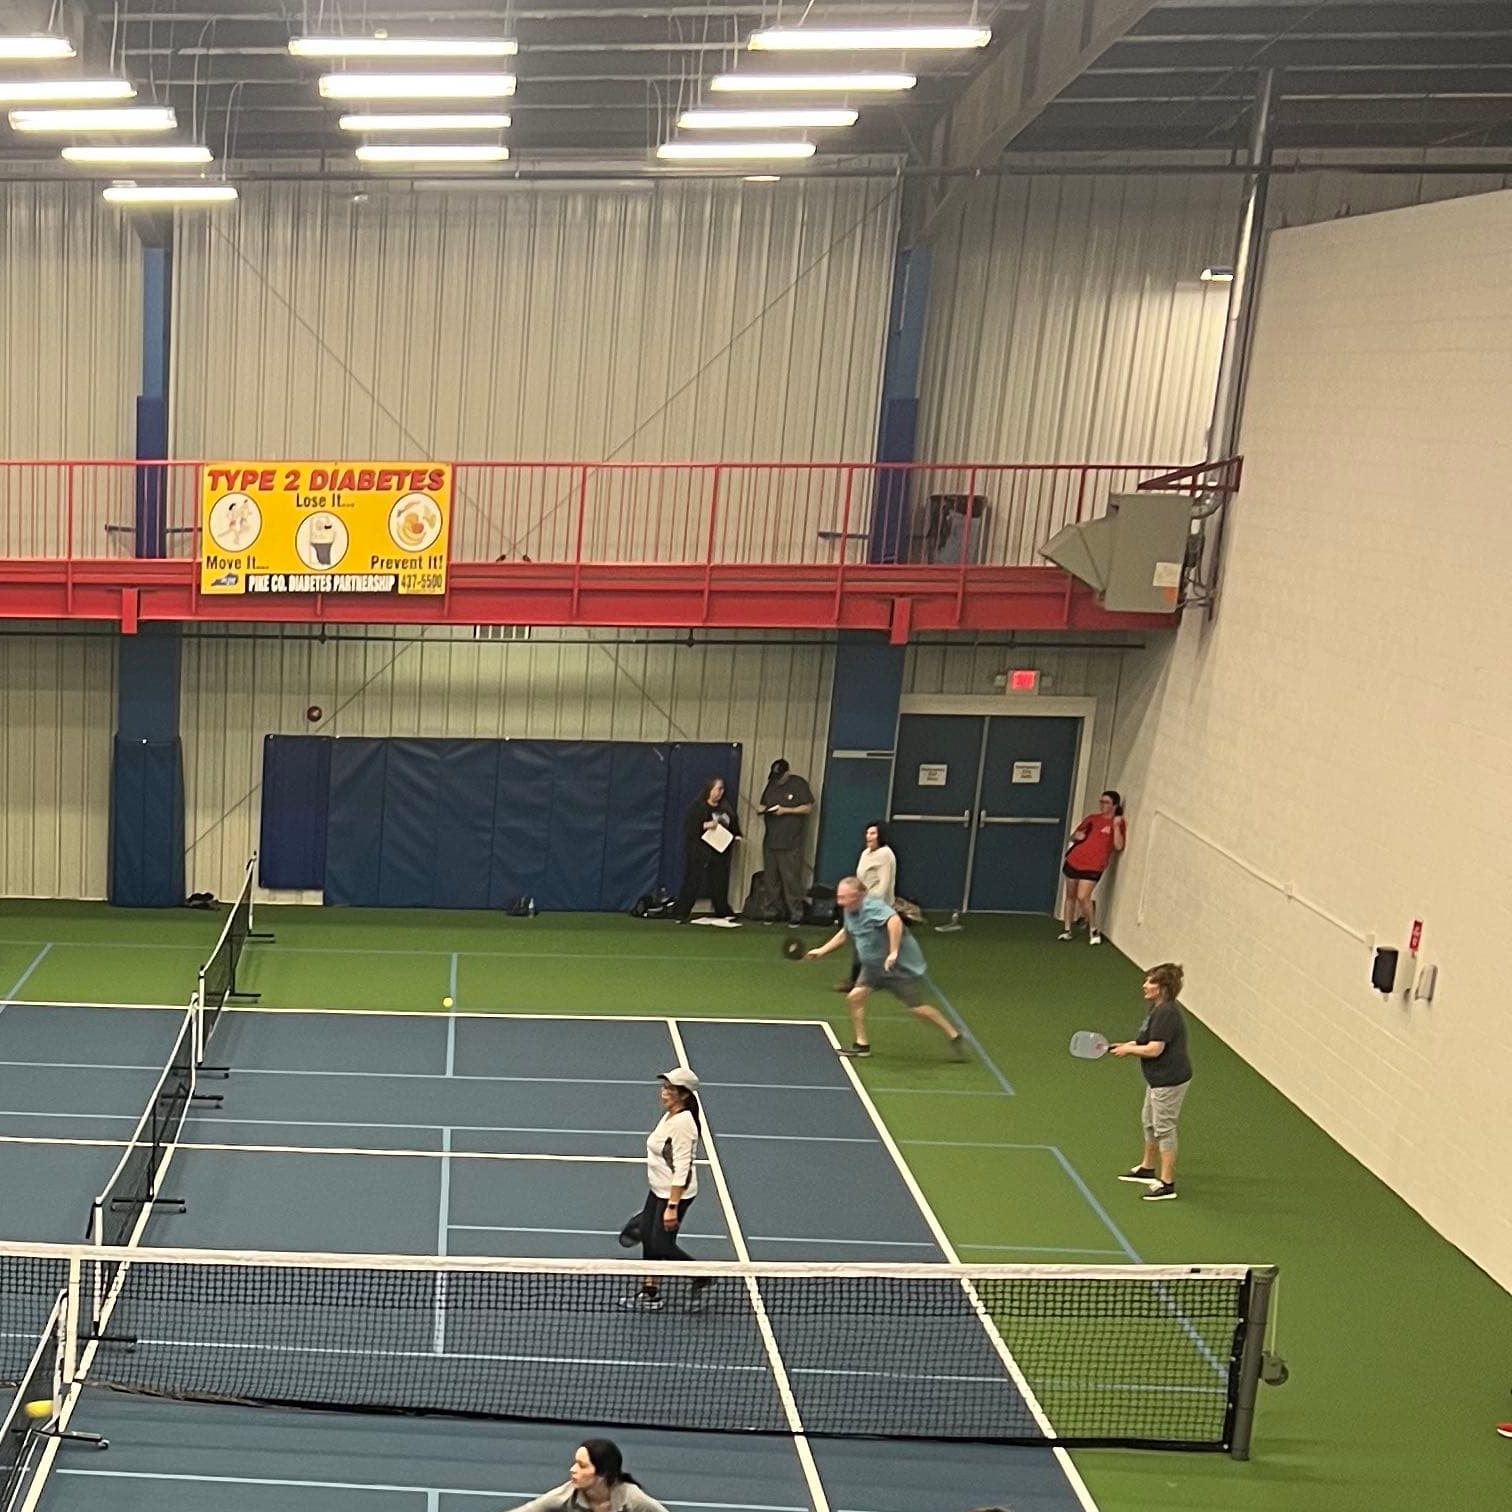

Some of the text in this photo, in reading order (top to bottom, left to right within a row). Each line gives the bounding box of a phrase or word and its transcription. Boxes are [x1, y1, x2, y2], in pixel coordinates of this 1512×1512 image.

[208, 469, 445, 491] TYPE 2 DIABETES
[296, 493, 327, 508] Lose
[206, 556, 242, 570] Move
[370, 555, 443, 570] Prevent It!
[248, 574, 396, 592] PIKE CO. DIABETES PARTNERSHIP
